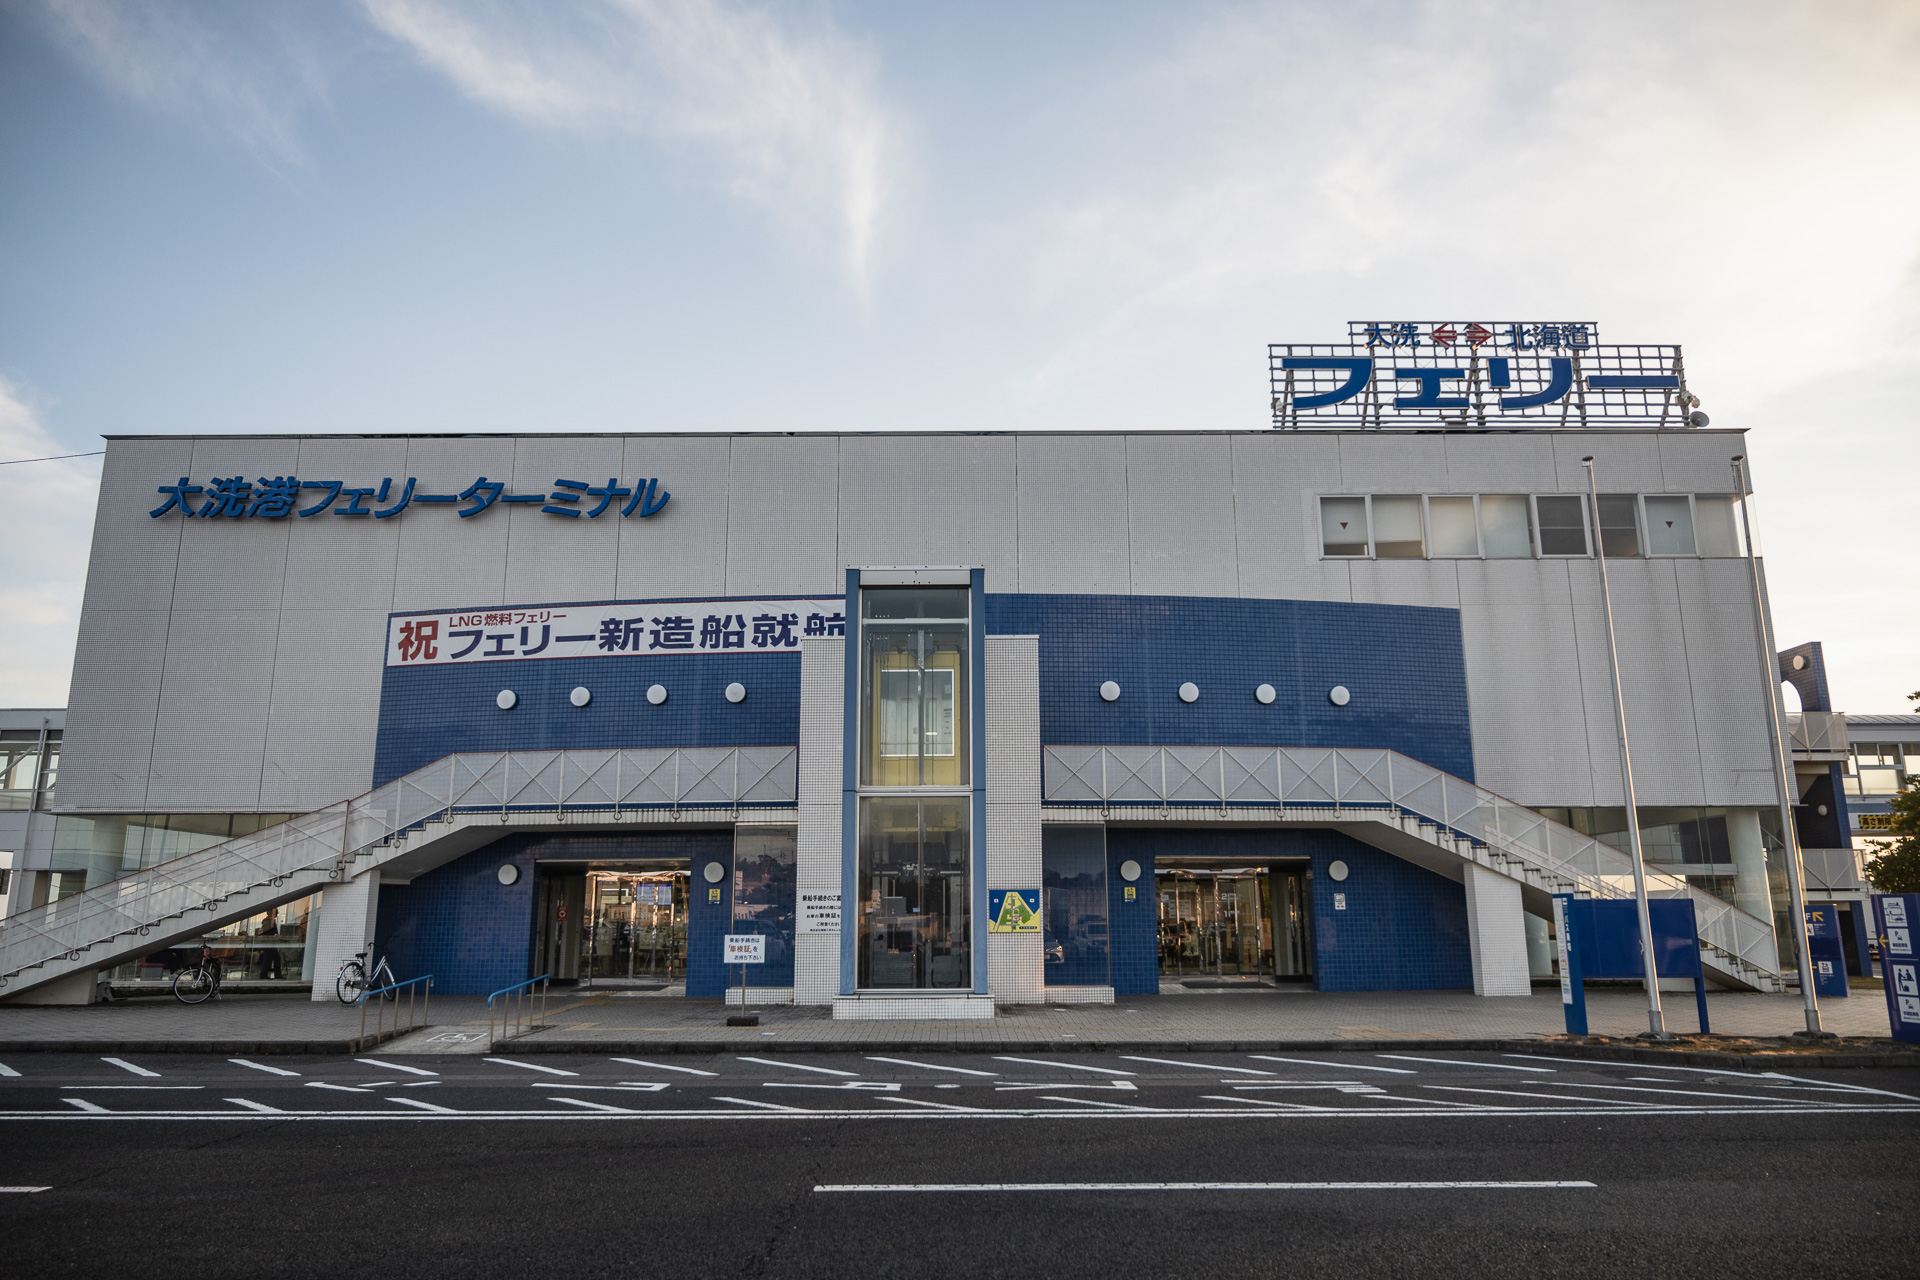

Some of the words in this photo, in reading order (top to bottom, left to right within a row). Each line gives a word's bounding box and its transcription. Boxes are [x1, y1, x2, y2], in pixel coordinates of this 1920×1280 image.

[1363, 322, 1421, 348] 大洗
[1505, 324, 1593, 351] 北海道
[1282, 358, 1680, 411] フェリー
[150, 476, 671, 518] 大洗港フェリーターミナル
[398, 620, 439, 662] 祝
